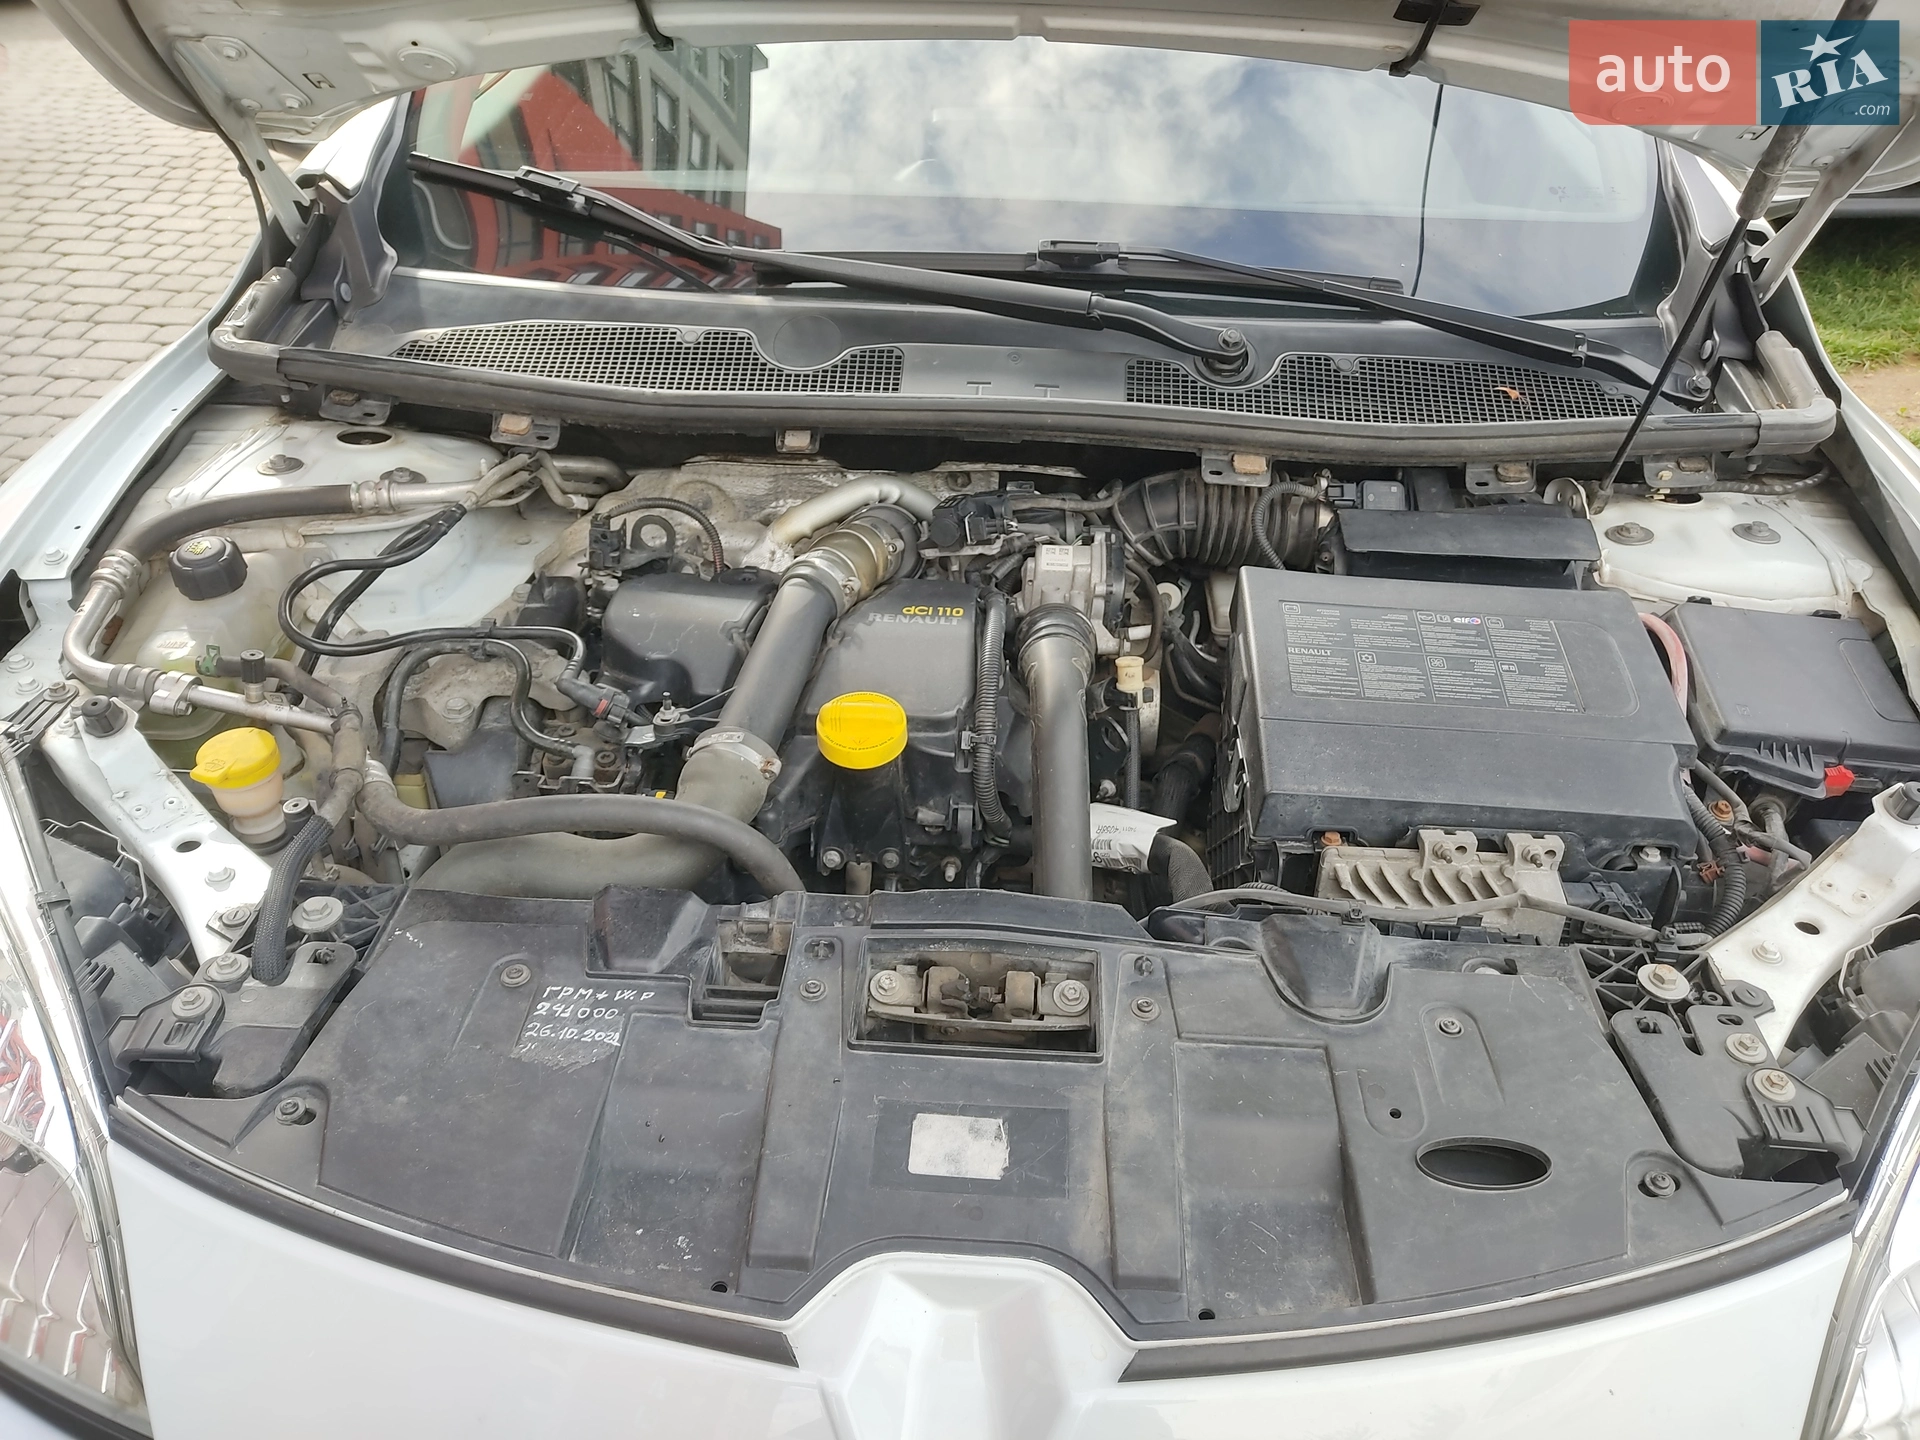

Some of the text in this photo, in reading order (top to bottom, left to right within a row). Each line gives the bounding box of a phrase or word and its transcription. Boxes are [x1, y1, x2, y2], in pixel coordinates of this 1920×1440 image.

[937, 606, 965, 617] 110
[867, 612, 962, 626] RENAULT
[1287, 647, 1332, 656] RENAULT
